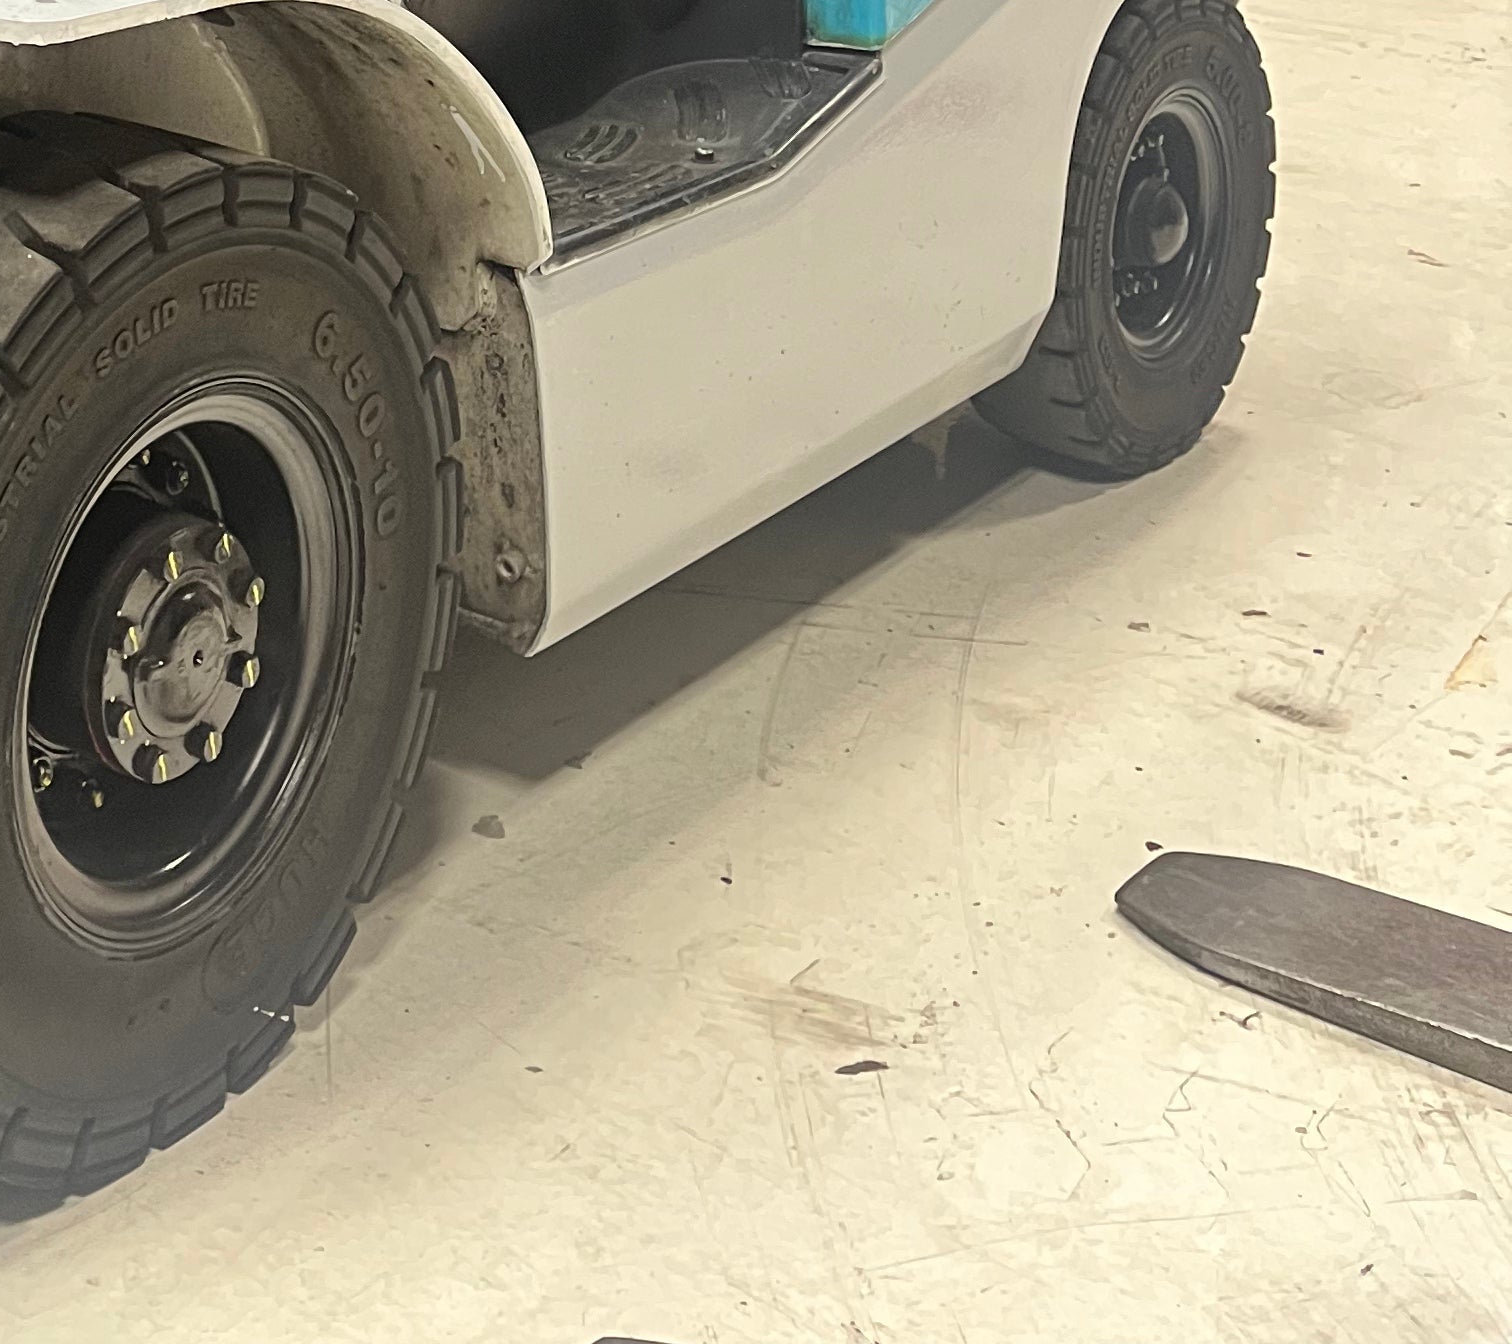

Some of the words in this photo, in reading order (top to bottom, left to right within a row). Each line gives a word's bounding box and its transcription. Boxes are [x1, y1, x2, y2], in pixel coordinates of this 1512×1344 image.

[94, 296, 178, 378] SOLID
[199, 279, 261, 312] TIRE
[314, 310, 401, 537] 6.50-10
